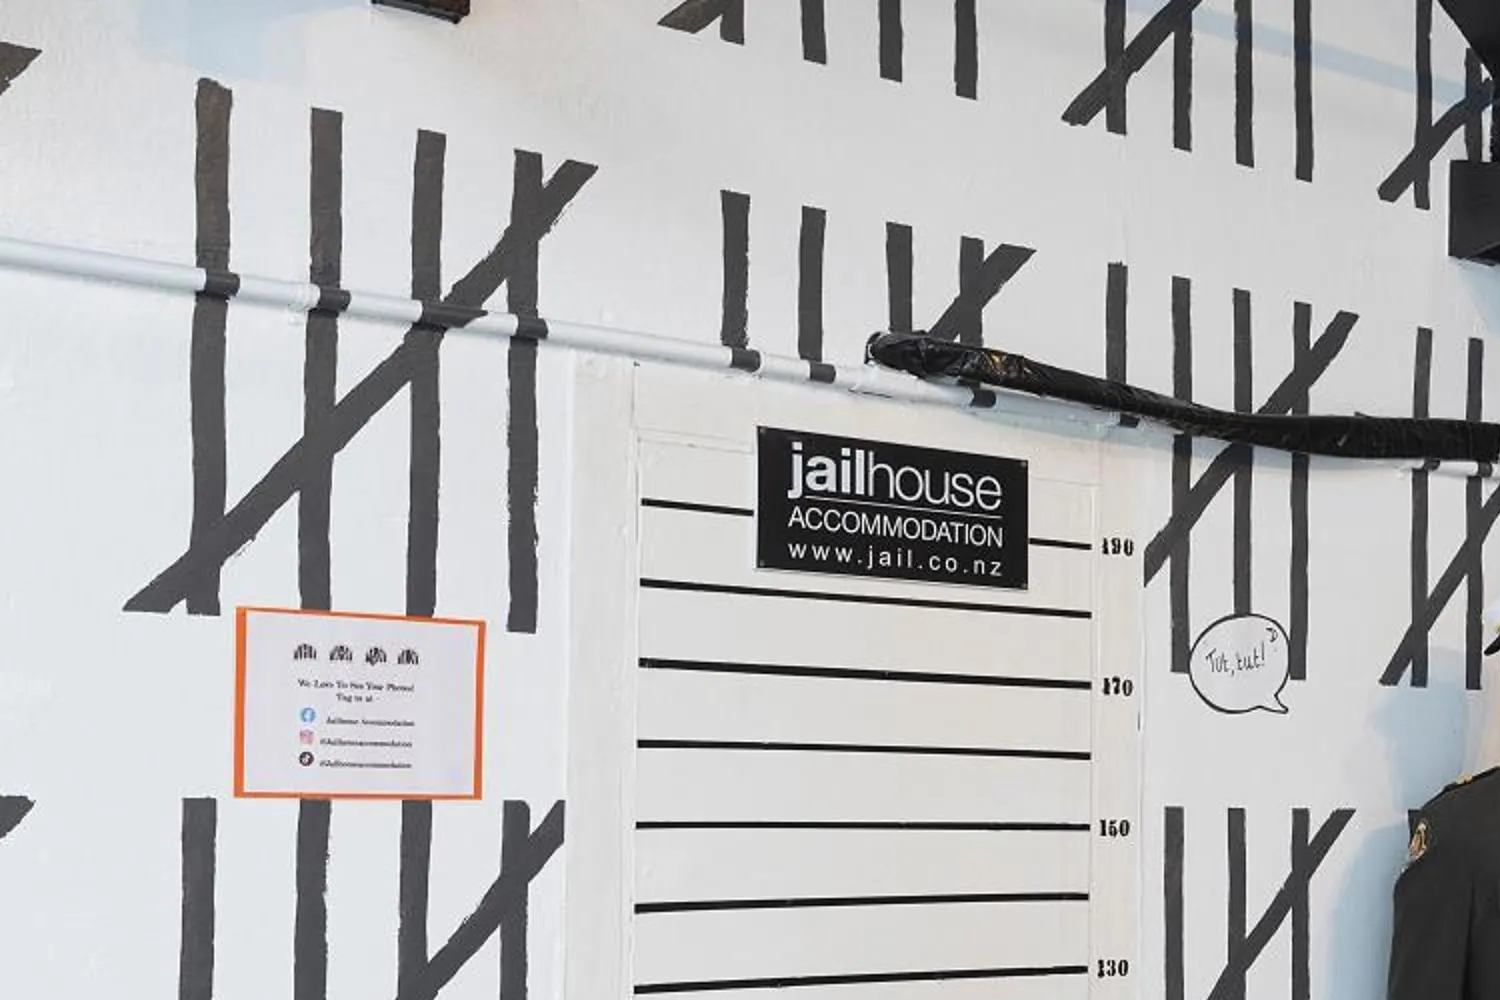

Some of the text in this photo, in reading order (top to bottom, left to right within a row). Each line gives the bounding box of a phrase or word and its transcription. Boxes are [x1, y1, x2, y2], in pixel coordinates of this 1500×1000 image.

[787, 441, 1002, 511] jailhouse
[788, 506, 1003, 548] ACCOMMODATION
[1101, 537, 1134, 556] 190
[788, 543, 1003, 577] www.jail.co.nz
[1102, 677, 1133, 697] 170
[1099, 819, 1130, 838] 150
[1097, 959, 1129, 978] 130
